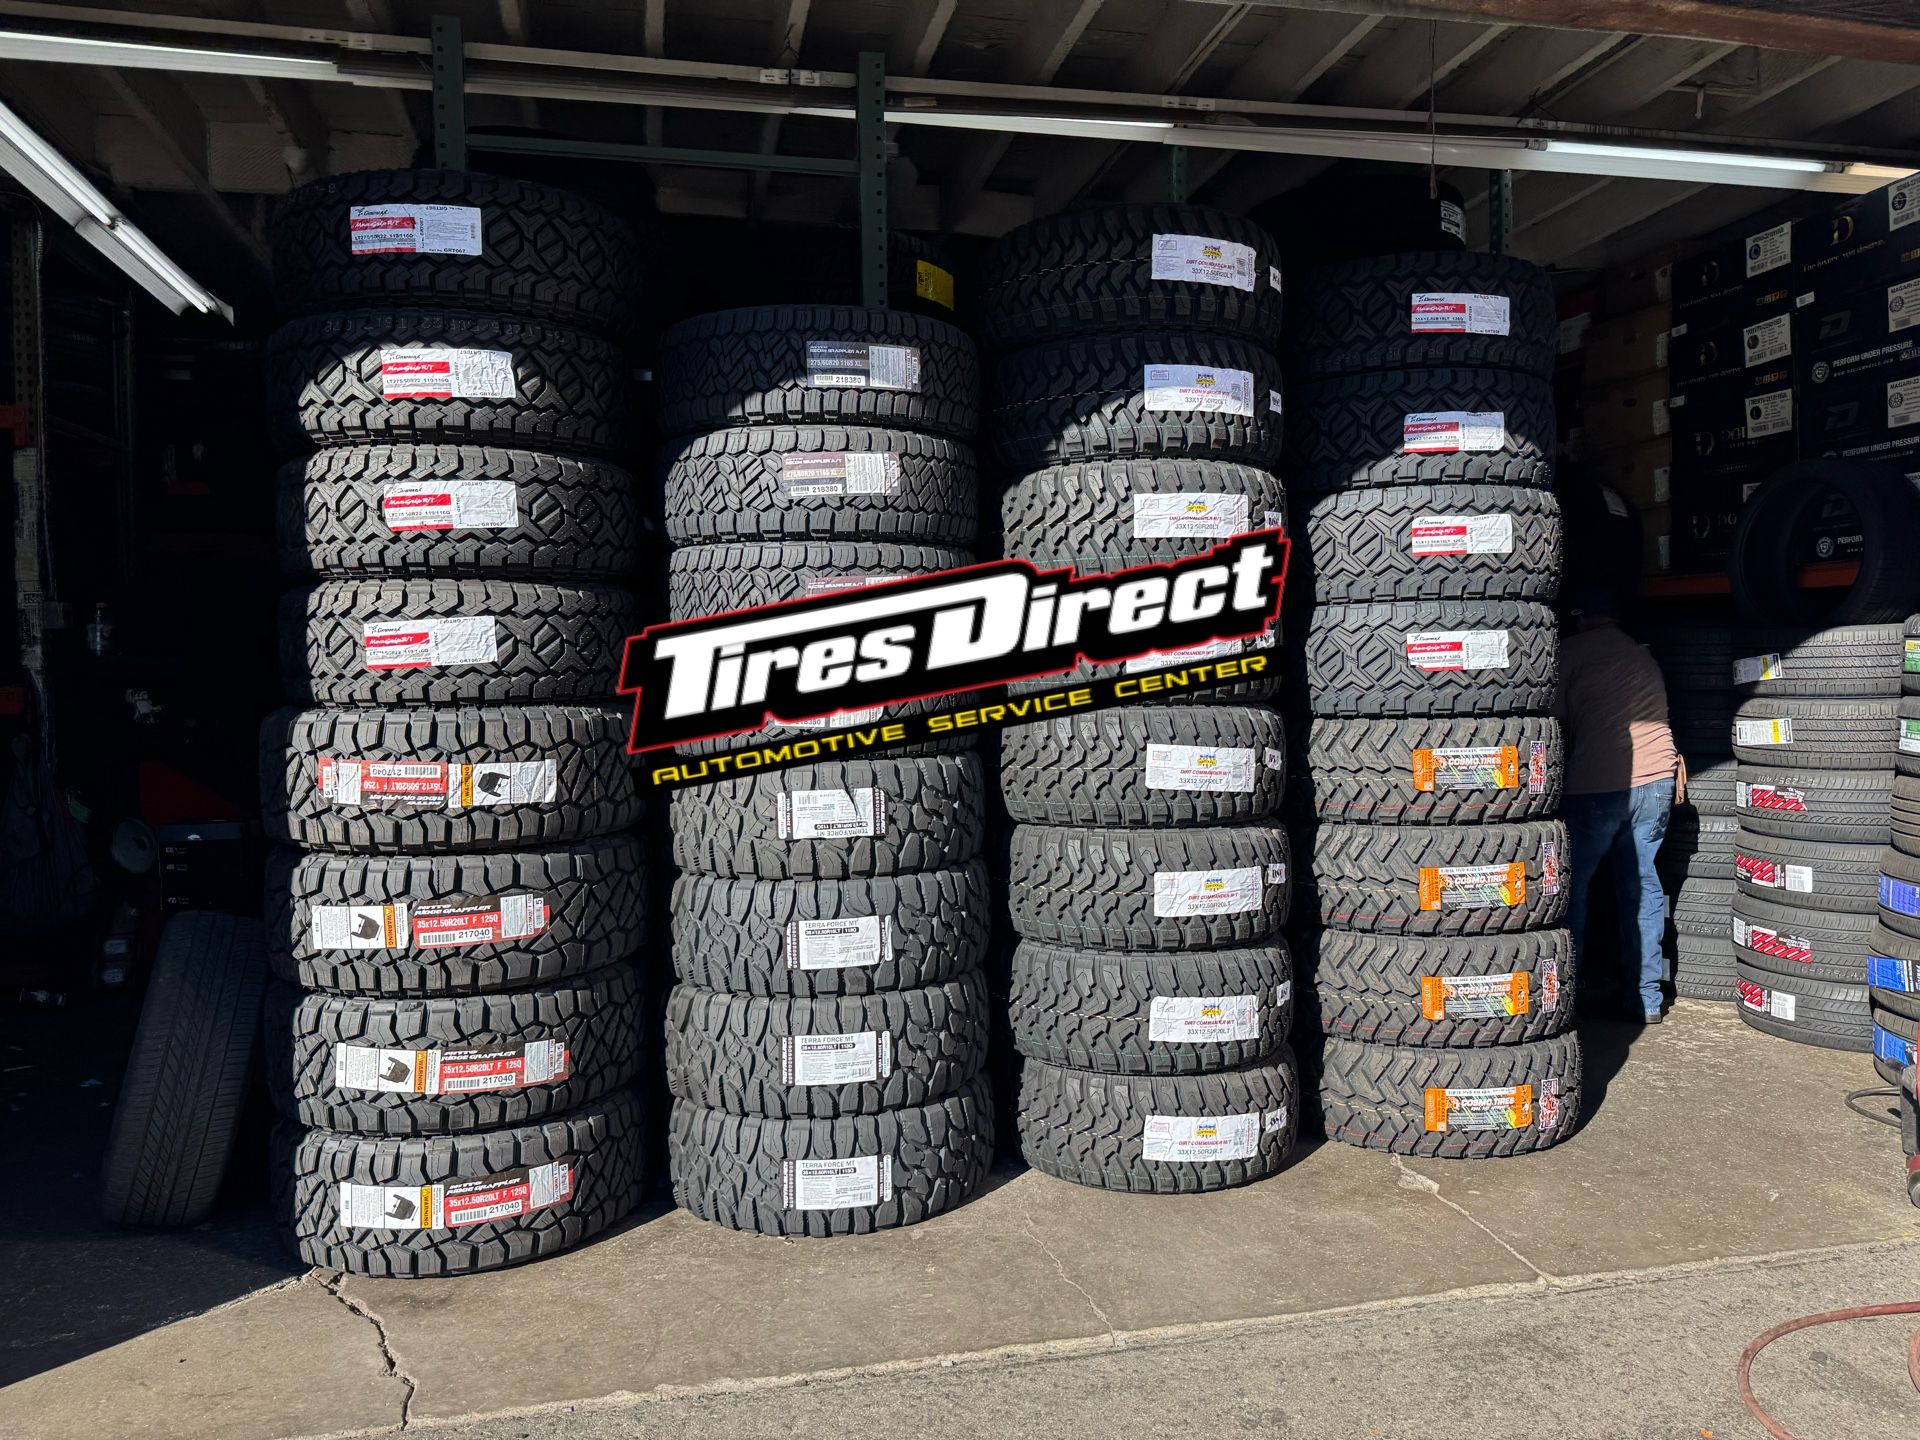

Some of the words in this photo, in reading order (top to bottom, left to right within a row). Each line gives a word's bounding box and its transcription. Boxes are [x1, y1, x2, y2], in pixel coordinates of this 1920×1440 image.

[1833, 354, 1861, 368] PERFORM
[1861, 348, 1881, 361] UNDER
[1881, 340, 1913, 355] PRESSURE
[1842, 446, 1870, 457] PERFORM
[1870, 441, 1891, 452] UNDER
[812, 485, 838, 493] 218380
[372, 768, 401, 776] 217040
[443, 905, 491, 914] GRAPPLER
[417, 918, 470, 928] 35x12.50R20LT
[385, 914, 395, 946] WARNING
[458, 929, 490, 939] 217040
[440, 1054, 469, 1062] RIDGE
[469, 1051, 517, 1060] GRAPPLER
[443, 1062, 494, 1074] 35x12.50R20LT
[416, 1059, 426, 1091] WARNING
[482, 1074, 513, 1085] 217040
[446, 1187, 475, 1195] RIDGE
[474, 1177, 521, 1190] GRAPPLER
[449, 1193, 500, 1207] 35x12.50R20LT
[421, 1195, 431, 1227] WARNING
[489, 1201, 520, 1214] 217040
